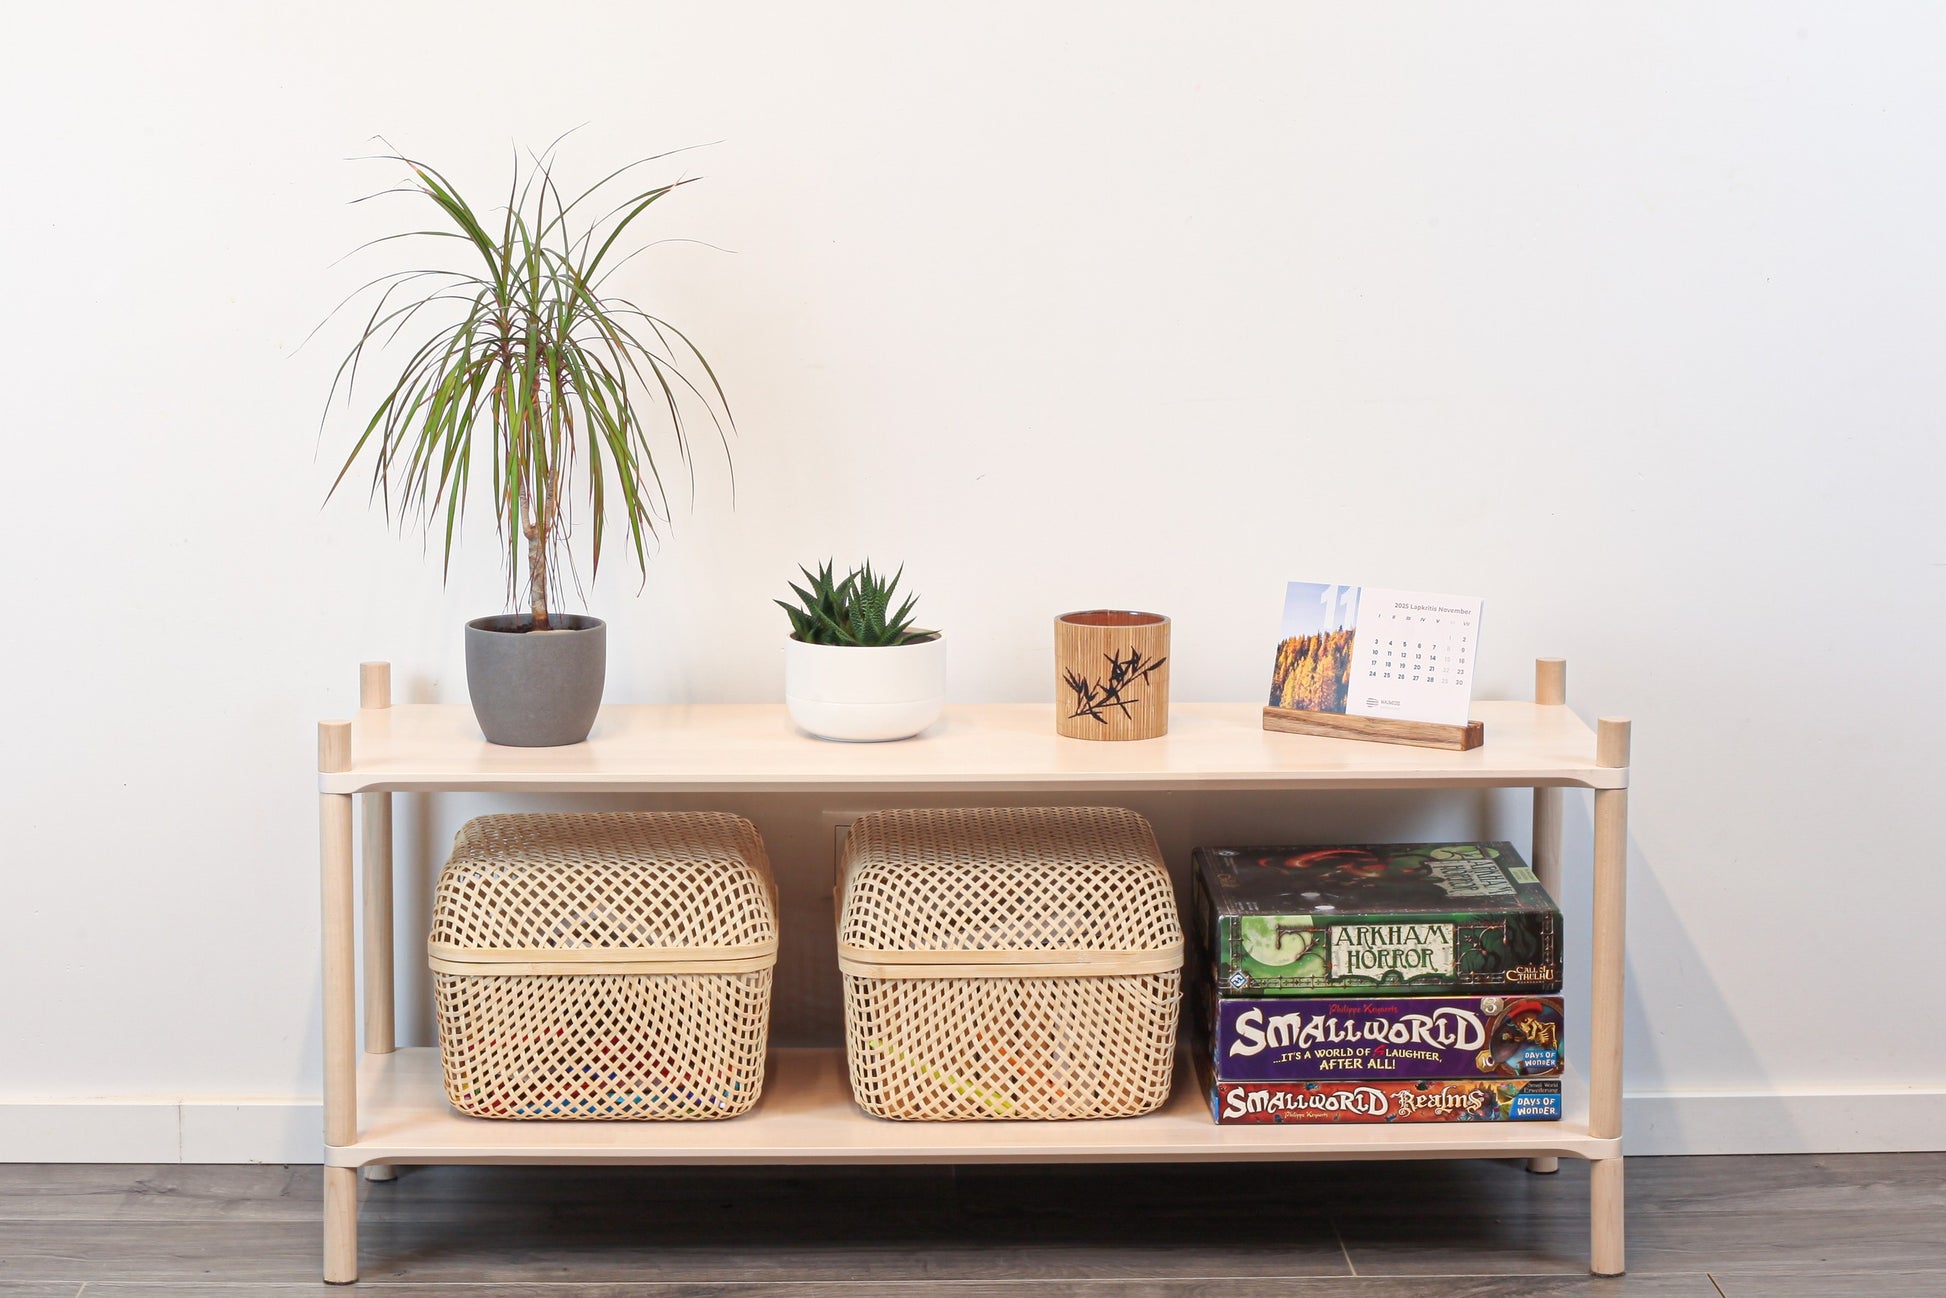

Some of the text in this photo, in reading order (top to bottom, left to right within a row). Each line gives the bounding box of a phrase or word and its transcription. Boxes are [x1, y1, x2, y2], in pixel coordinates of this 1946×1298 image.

[1320, 584, 1358, 630] 11
[1410, 604, 1437, 612] Lapkritis
[1439, 607, 1471, 615] November
[1335, 925, 1450, 950] ARKHAM
[1347, 948, 1439, 973] HORROR
[1506, 970, 1554, 981] CTHULHU
[1516, 966, 1538, 974] CALL
[1304, 1051, 1311, 1059] A
[1314, 1049, 1353, 1058] WORLD
[1356, 1048, 1371, 1056] OF
[1320, 1058, 1396, 1071] AFTER ALL!
[1525, 1059, 1556, 1067] WONDER
[1390, 1085, 1485, 1117] Realms
[1517, 1097, 1555, 1105] DAYS OF
[1517, 1107, 1556, 1116] WONDER
